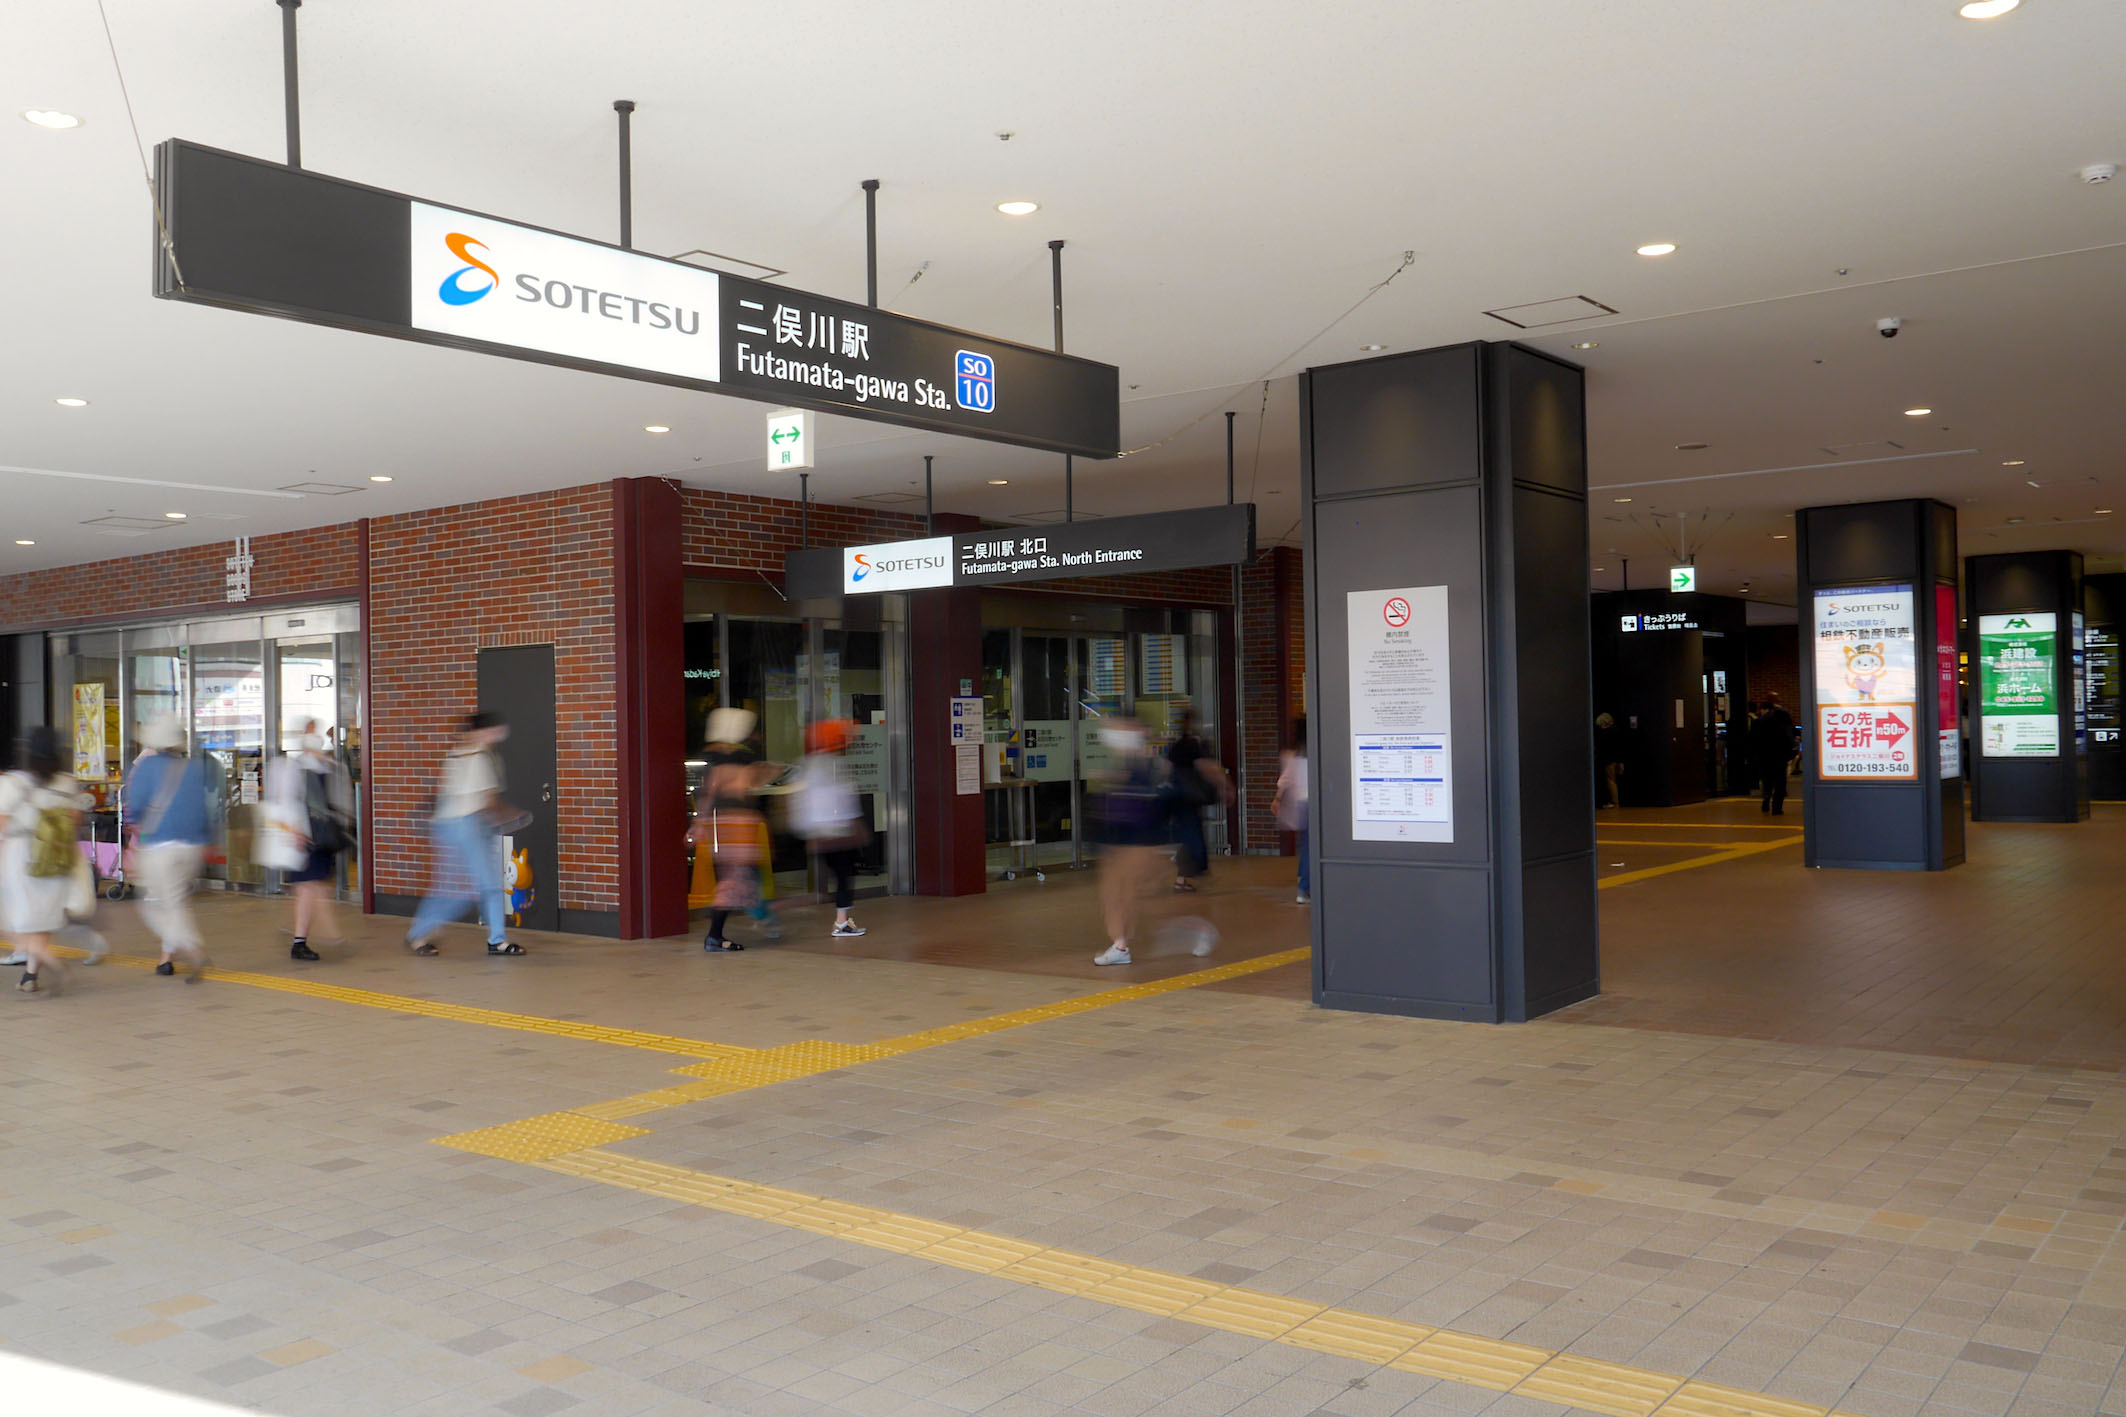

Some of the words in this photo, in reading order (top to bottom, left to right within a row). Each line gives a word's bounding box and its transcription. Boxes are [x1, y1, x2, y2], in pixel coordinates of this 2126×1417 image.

[515, 273, 699, 335] SOTETSU
[737, 300, 870, 361] 二俣川駅
[963, 358, 987, 376] SO
[737, 343, 909, 402] Futamata-gawa
[914, 378, 952, 410] Sta.
[963, 379, 989, 408] 10
[961, 540, 1015, 560] 二俣川駅
[1020, 537, 1047, 555] 北口
[875, 555, 945, 574] SOTETSU
[962, 558, 1038, 575] Futamata-gawa
[1040, 555, 1060, 568] Sta.
[1062, 551, 1093, 566] North
[1095, 547, 1143, 563] Entrance
[1843, 603, 1900, 613] SOTETSU
[1643, 612, 1687, 623] きっぷうりば
[1644, 623, 1666, 631] Tickets
[1820, 627, 1910, 640] 相鉄不動産販売
[1996, 682, 2043, 694] 浜ホーム
[1827, 711, 1873, 726] この先
[1826, 727, 1873, 748] 右折
[1838, 763, 1910, 773] 0120-193-540
